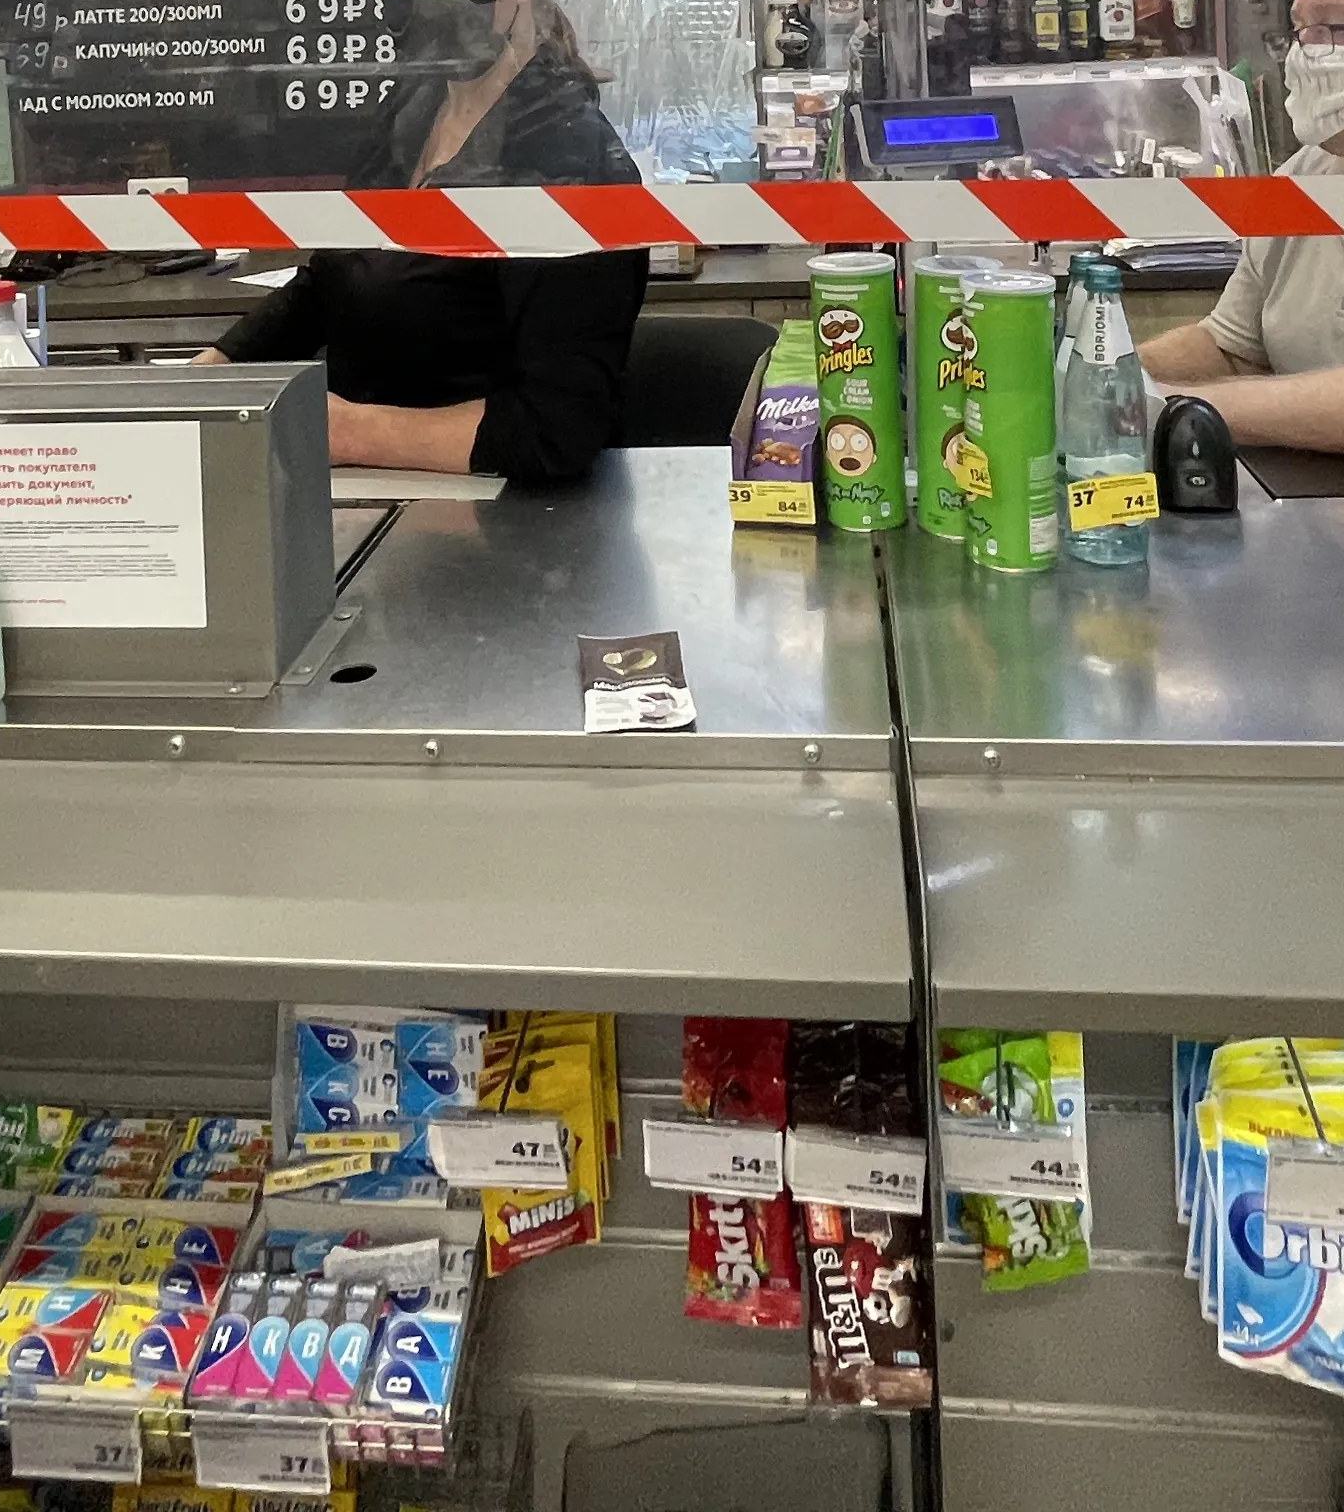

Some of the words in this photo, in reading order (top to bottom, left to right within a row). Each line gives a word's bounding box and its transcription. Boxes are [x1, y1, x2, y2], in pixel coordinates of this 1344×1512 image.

[74, 8, 125, 25] ЛАТТЕ
[129, 4, 223, 25] 200/300МЛ
[75, 41, 168, 60] КАПУЧИНО
[171, 37, 266, 57] 200/300МЛ
[51, 95, 62, 111] С
[66, 92, 151, 111] МОЛОКОМ
[154, 90, 185, 107] 200
[189, 90, 214, 106] МЛ
[1094, 304, 1106, 362] BORJOMI
[819, 343, 874, 380] Pringles
[757, 396, 819, 420] Milka
[37, 446, 77, 459] право
[18, 462, 96, 474] покупателя
[28, 479, 96, 492] документ,
[729, 490, 751, 502] 39
[1072, 491, 1094, 507] 37
[1124, 495, 1144, 509] 74
[778, 501, 797, 512] 84
[511, 1141, 540, 1157] 47
[731, 1156, 761, 1173] 54
[1030, 1159, 1062, 1176] 44
[869, 1170, 900, 1188] 54
